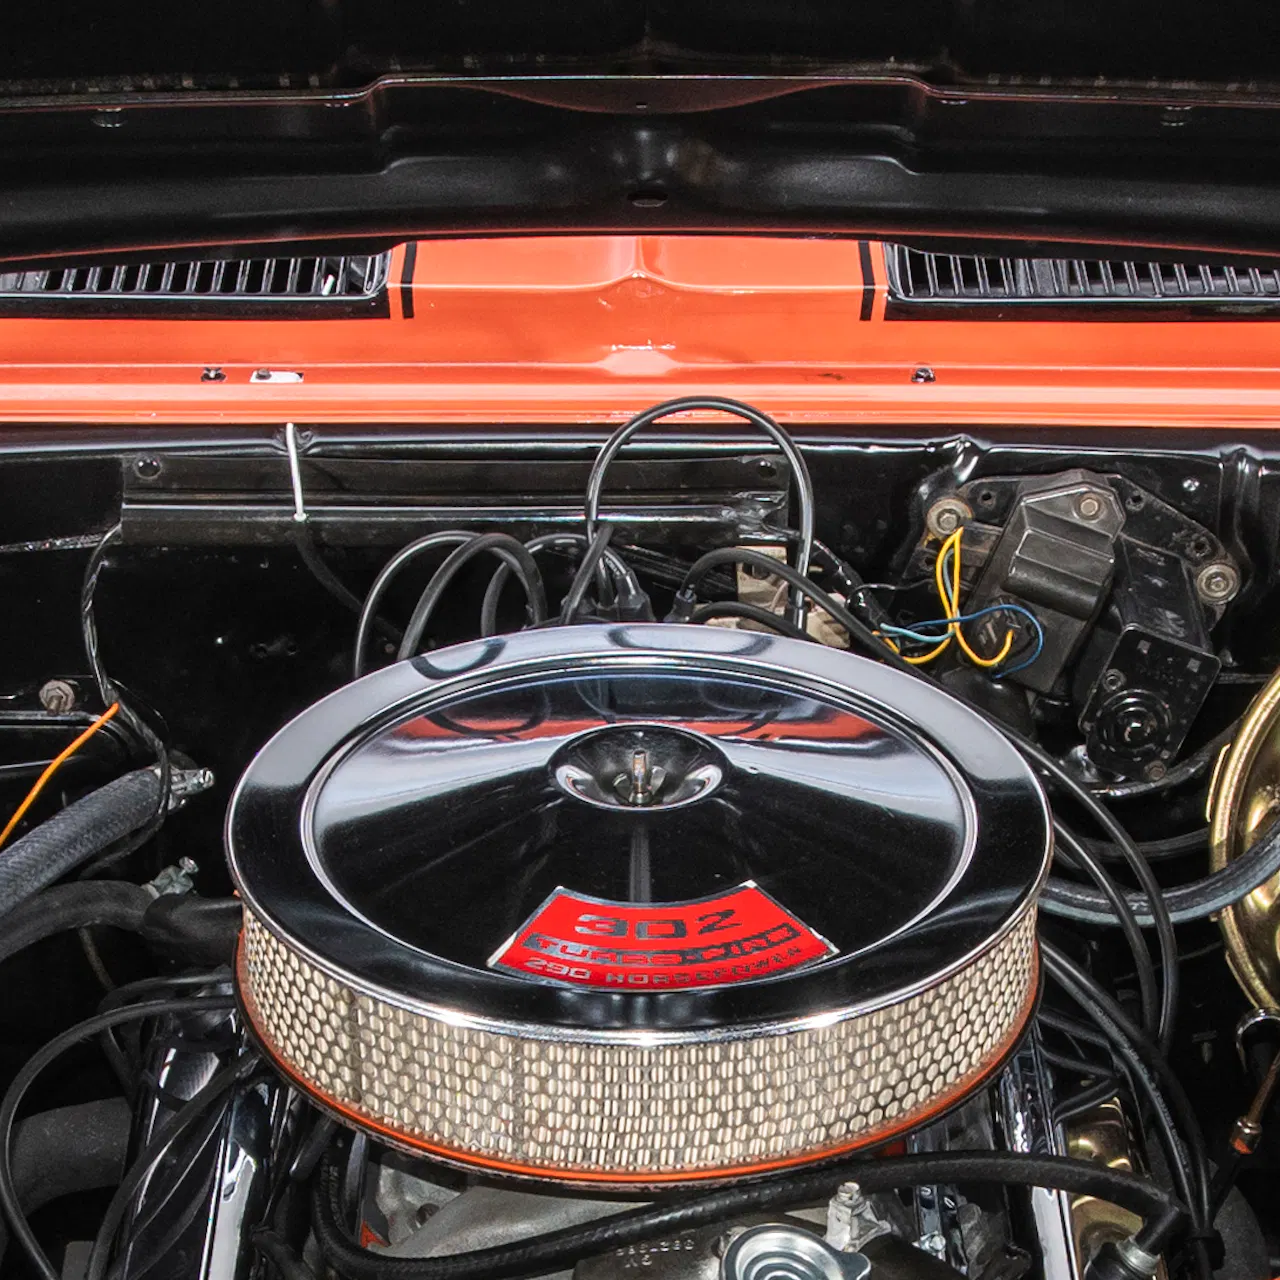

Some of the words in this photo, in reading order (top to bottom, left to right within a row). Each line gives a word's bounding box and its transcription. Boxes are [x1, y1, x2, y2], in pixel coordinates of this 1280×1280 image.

[574, 909, 742, 940] 302
[532, 924, 795, 965] TURBO-FIRE
[524, 957, 591, 980] 290
